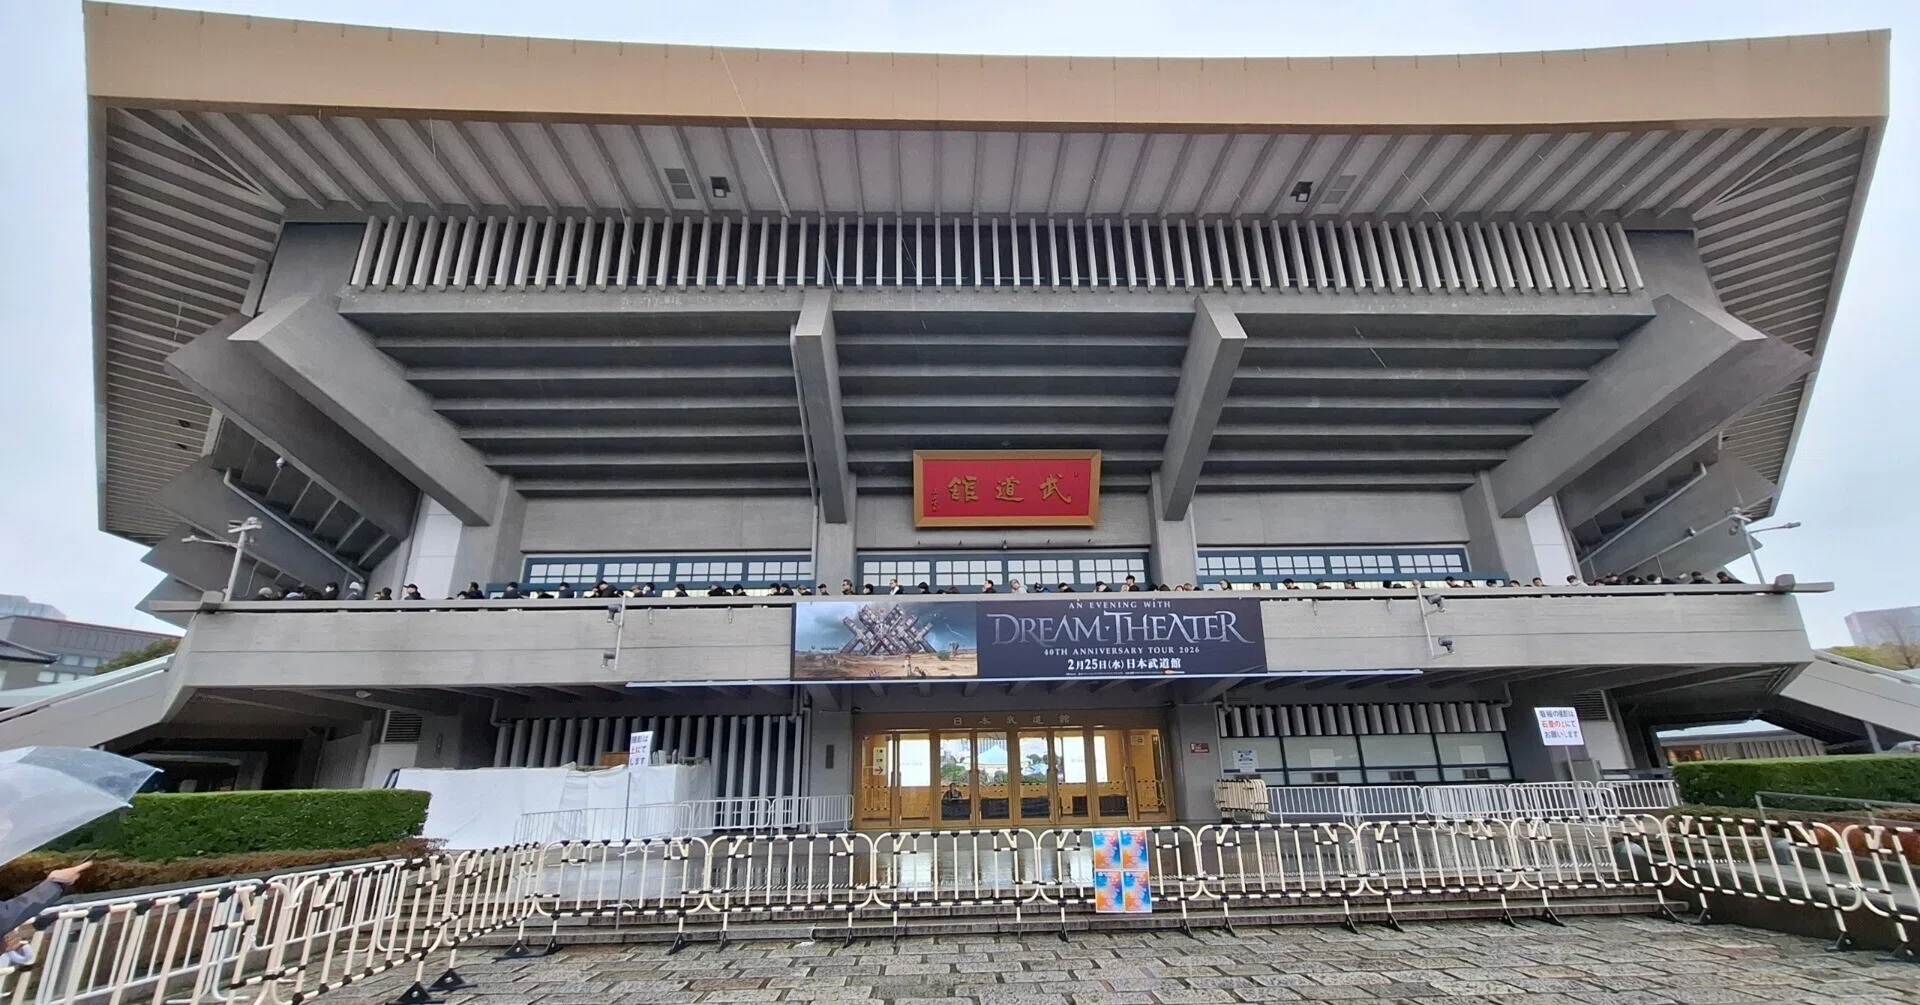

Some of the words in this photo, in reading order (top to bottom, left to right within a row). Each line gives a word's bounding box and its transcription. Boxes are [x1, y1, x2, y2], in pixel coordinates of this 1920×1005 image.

[1089, 601, 1137, 609] EVENING
[986, 613, 1109, 648] DREAM
[1103, 610, 1256, 645] THEATER
[1043, 648, 1068, 656] 40TH
[1072, 647, 1143, 655] ANNIVERSARY
[1147, 646, 1175, 654] TOUR
[1179, 646, 1200, 654] 2026
